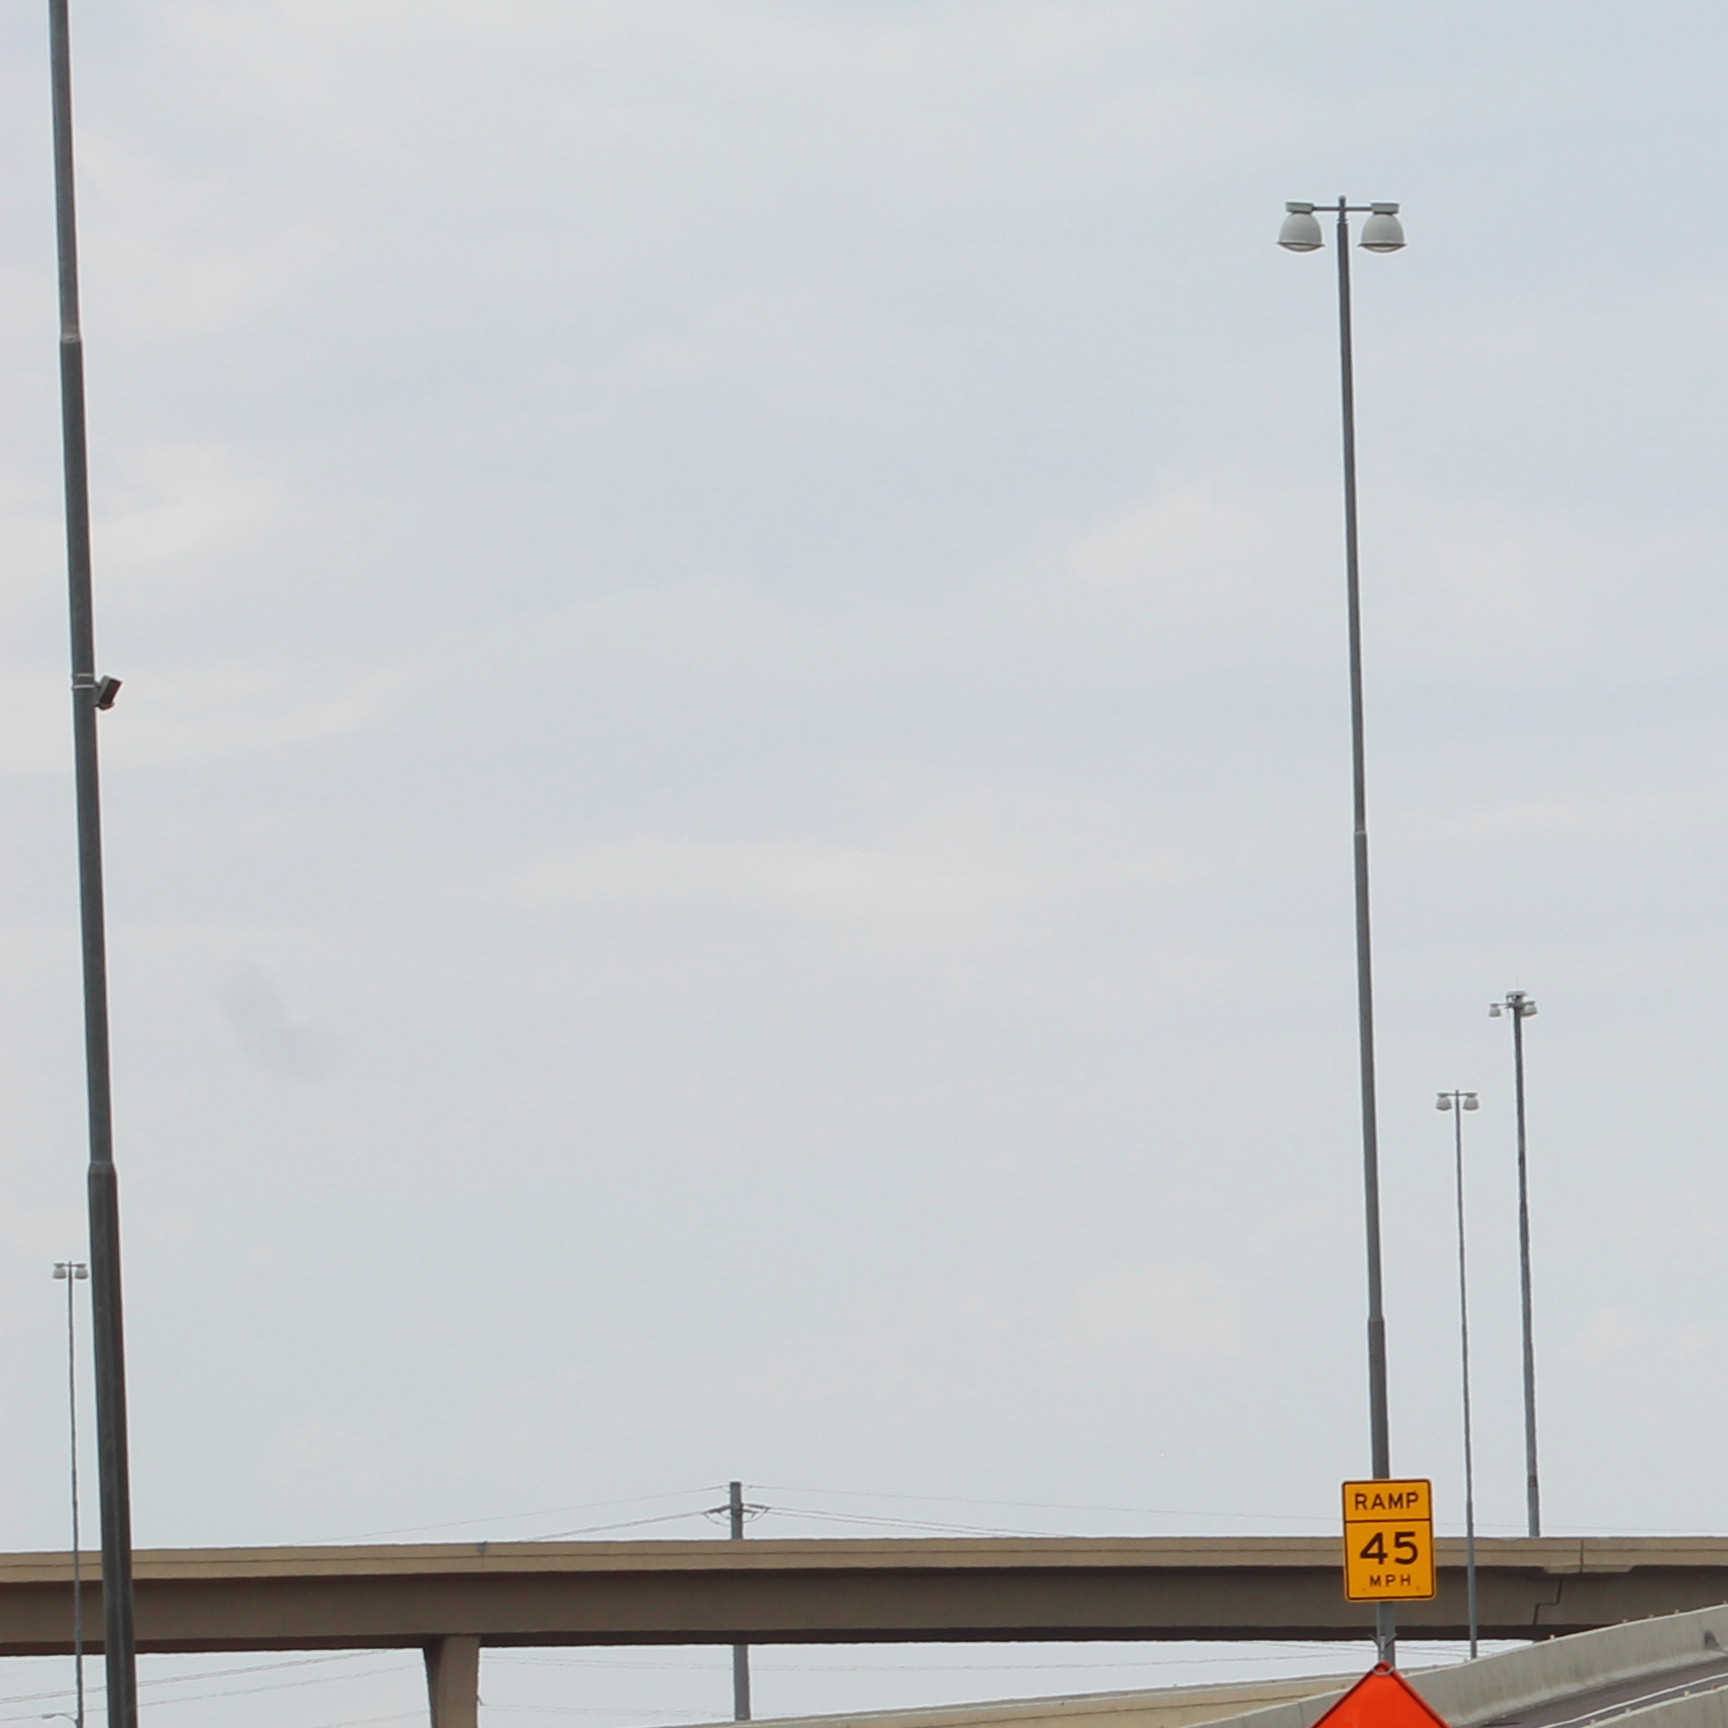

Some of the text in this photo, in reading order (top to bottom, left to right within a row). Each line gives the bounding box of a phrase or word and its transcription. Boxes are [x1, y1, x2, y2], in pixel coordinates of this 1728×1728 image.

[1355, 1493, 1418, 1510] RAMP
[1360, 1532, 1418, 1565] 45
[1370, 1574, 1411, 1588] MPH
